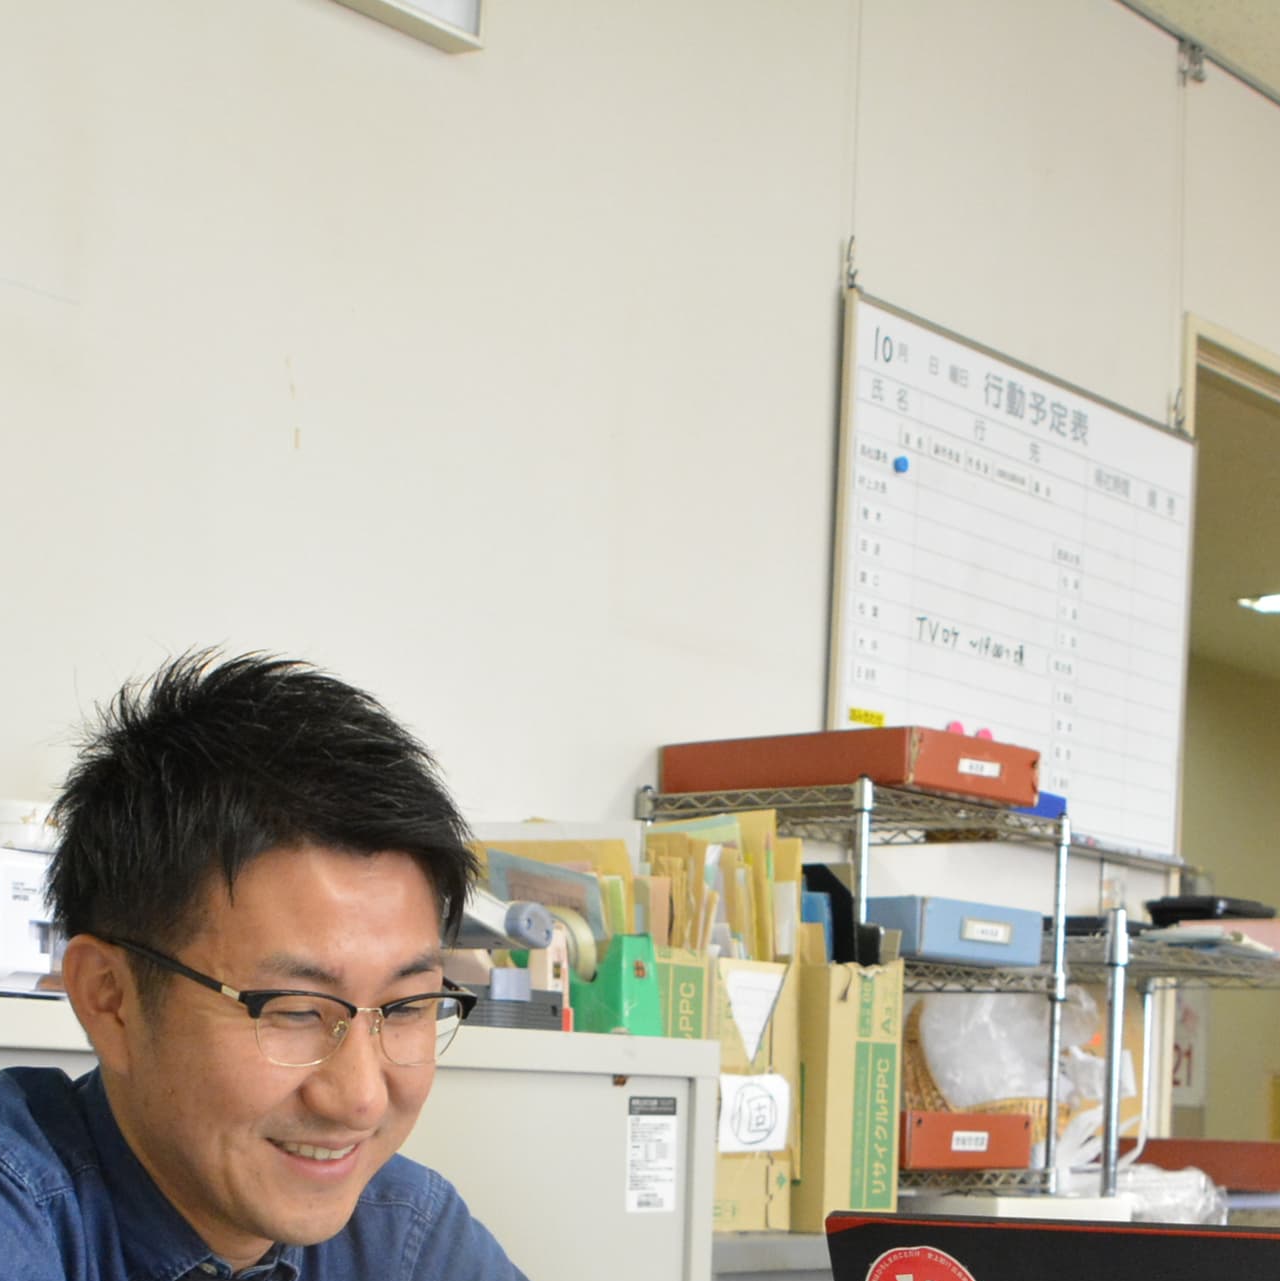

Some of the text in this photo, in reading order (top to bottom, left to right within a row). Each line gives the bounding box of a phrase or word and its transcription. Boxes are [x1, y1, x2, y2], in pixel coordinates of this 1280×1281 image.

[983, 371, 1090, 447] 行動予定表
[871, 1057, 891, 1195] リサイクルPPC
